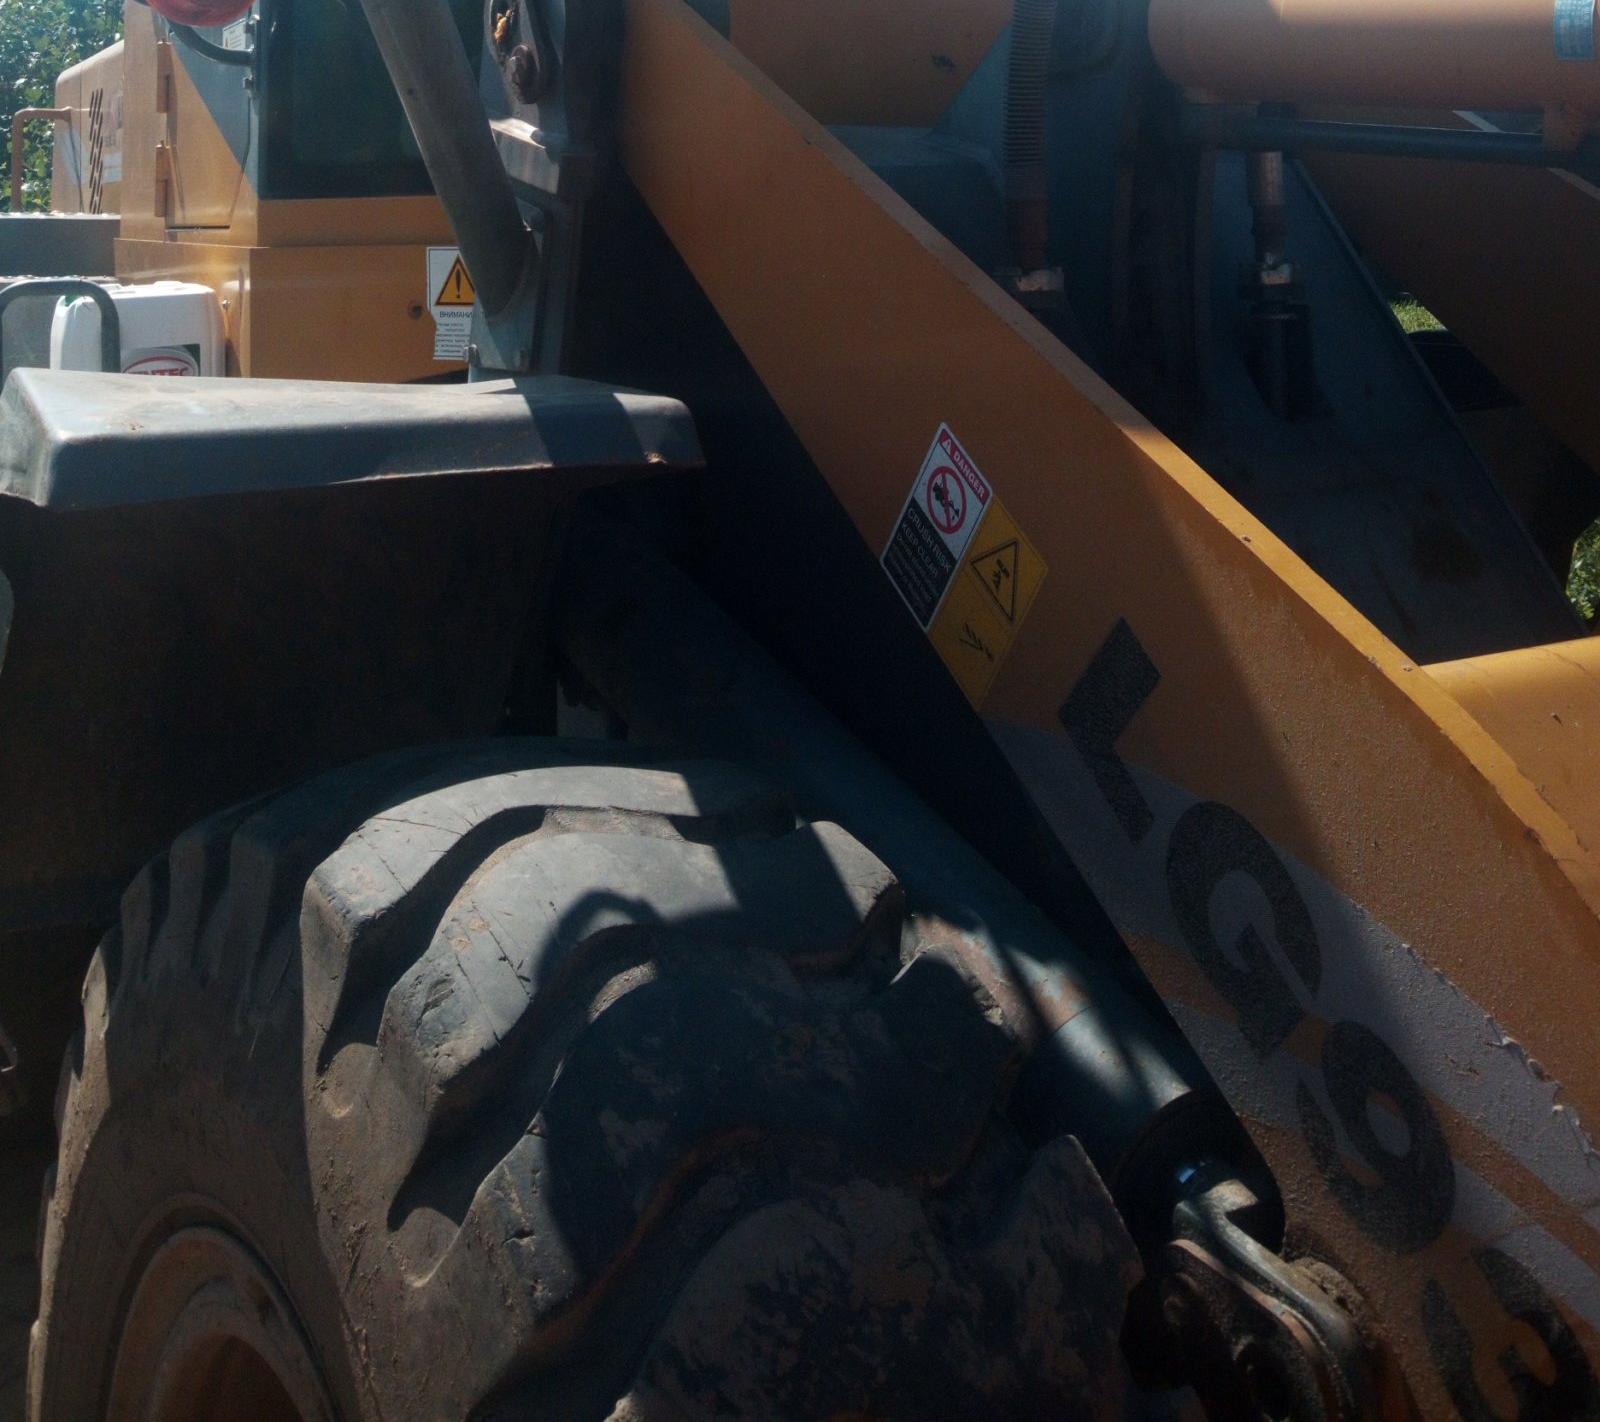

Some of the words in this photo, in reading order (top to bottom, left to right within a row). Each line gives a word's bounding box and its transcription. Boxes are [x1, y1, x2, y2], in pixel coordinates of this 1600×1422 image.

[439, 310, 473, 318] ВНИМАНИ
[952, 449, 985, 499] DANGER
[900, 519, 919, 549] KEEP
[915, 543, 939, 579] CLEAR
[905, 505, 935, 549] CRUSH
[931, 542, 952, 575] RISK
